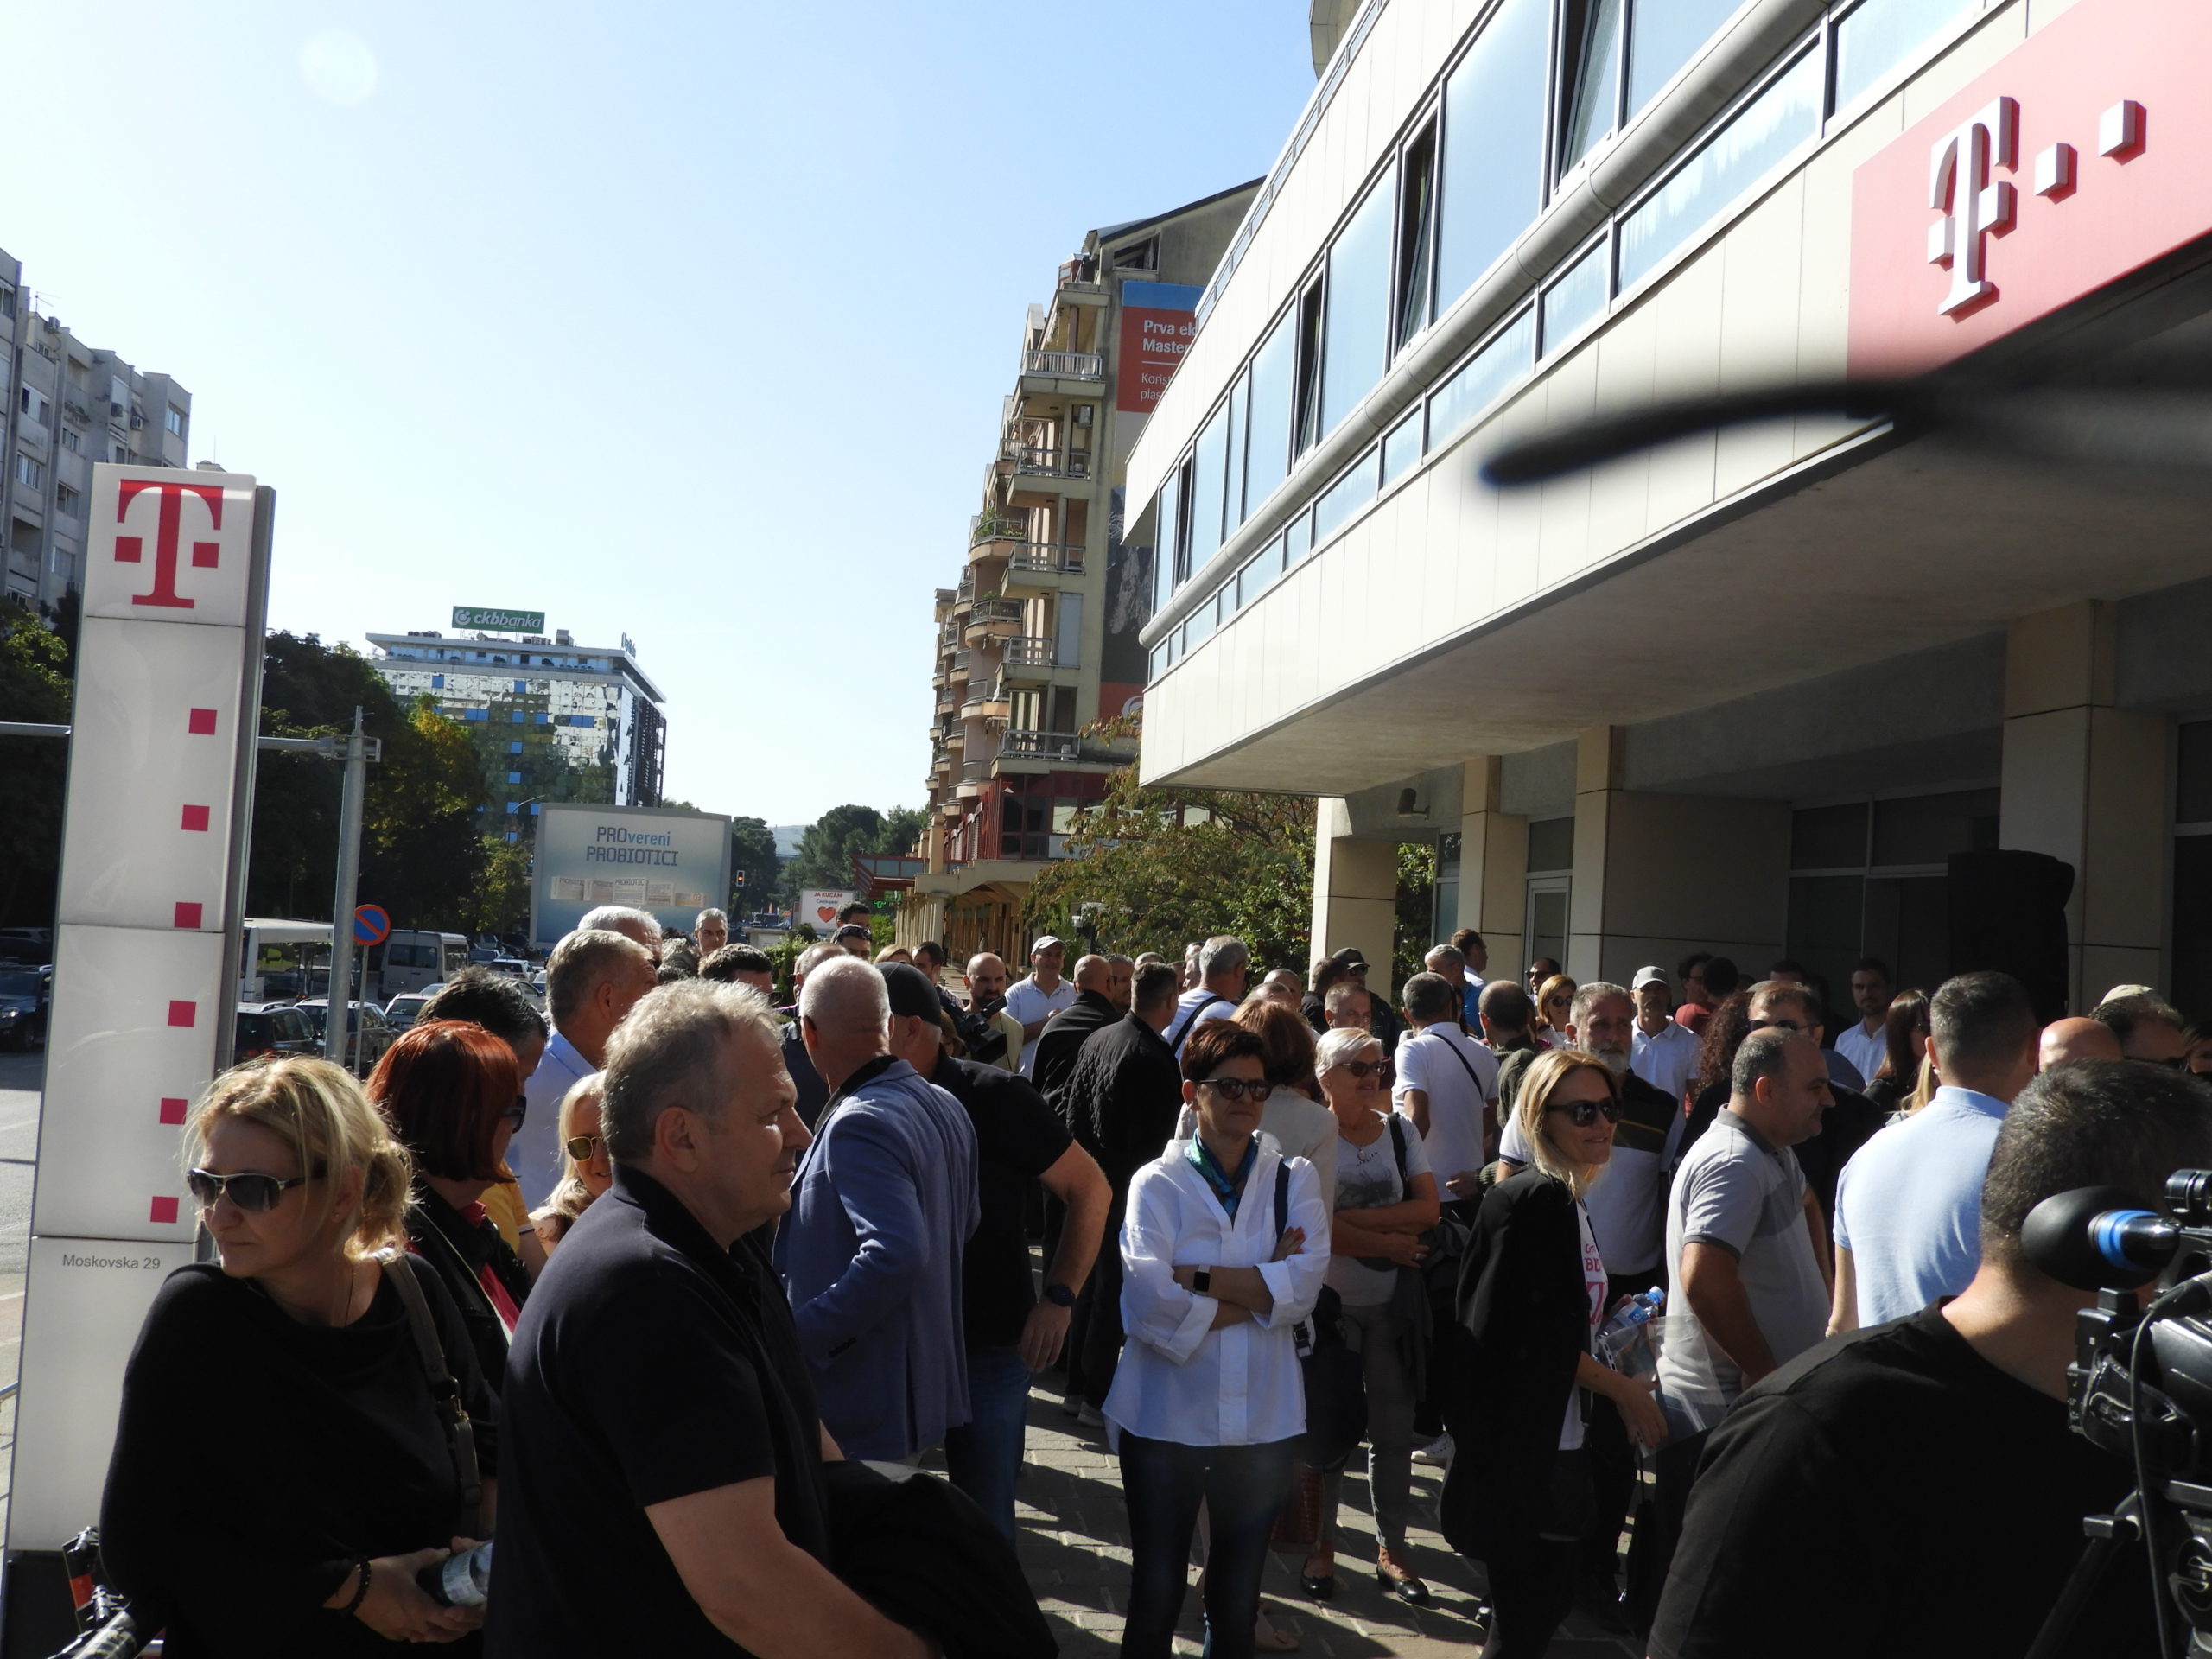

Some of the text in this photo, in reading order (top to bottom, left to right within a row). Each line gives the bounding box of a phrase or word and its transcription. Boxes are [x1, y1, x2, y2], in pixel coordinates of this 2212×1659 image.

[1928, 96, 2014, 317] T
[1143, 319, 1175, 335] Prva
[115, 479, 224, 609] T
[596, 825, 671, 847] PROvereni
[586, 846, 679, 867] PROBIOTICI
[62, 1254, 161, 1270] Moskovska 29
